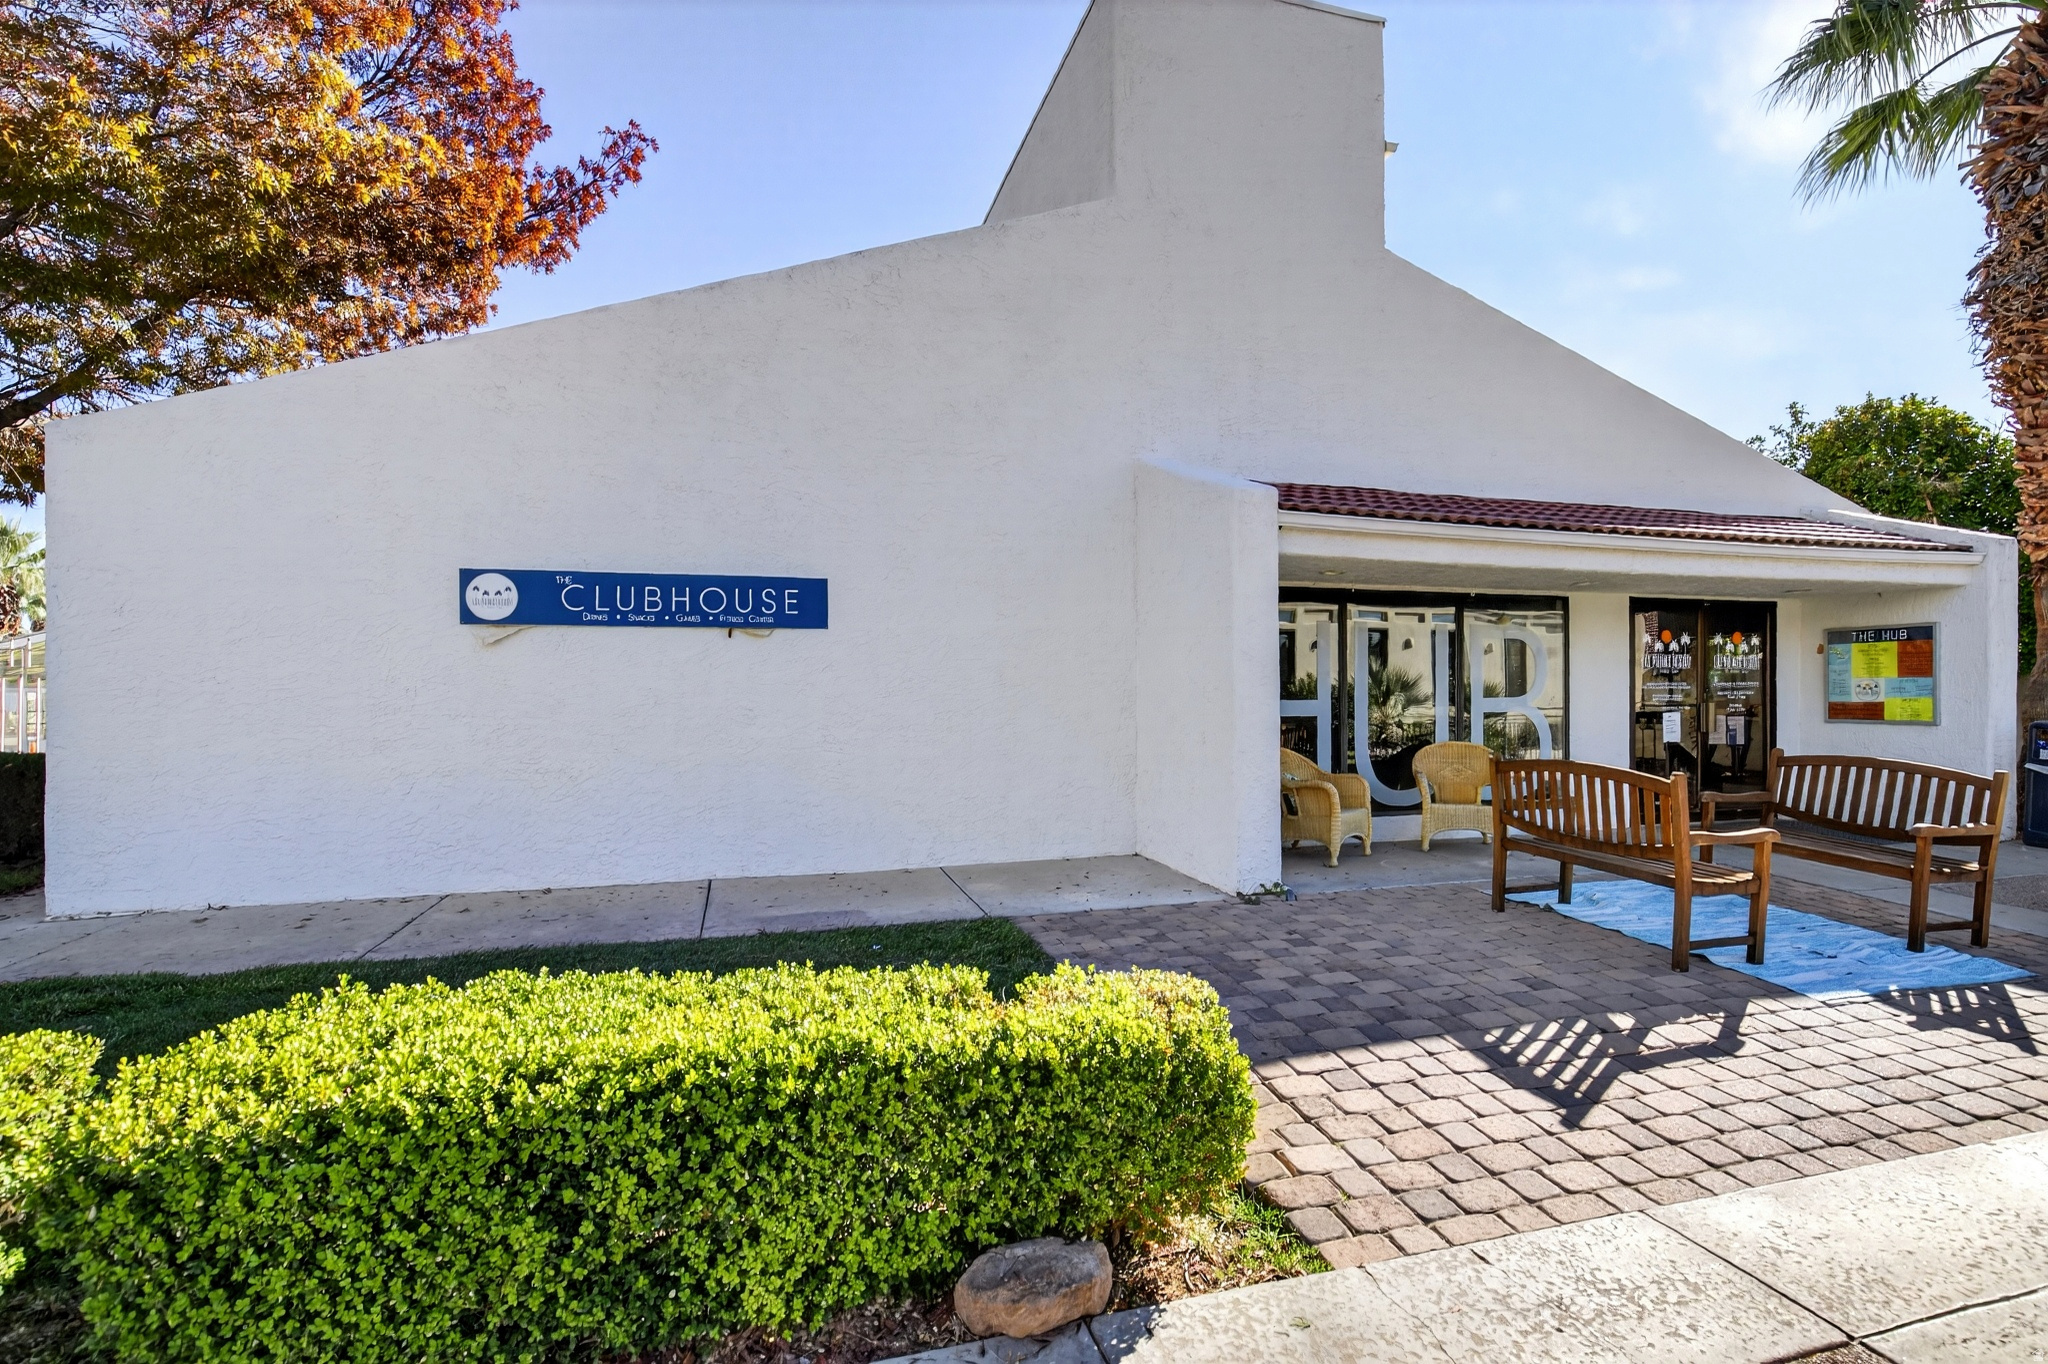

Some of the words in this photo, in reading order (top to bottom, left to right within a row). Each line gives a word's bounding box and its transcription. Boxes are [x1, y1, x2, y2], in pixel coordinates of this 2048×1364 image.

[556, 575, 573, 585] THE
[561, 584, 799, 614] CLUBHOUSE
[1851, 631, 1875, 642] THE
[1882, 629, 1908, 640] HUB
